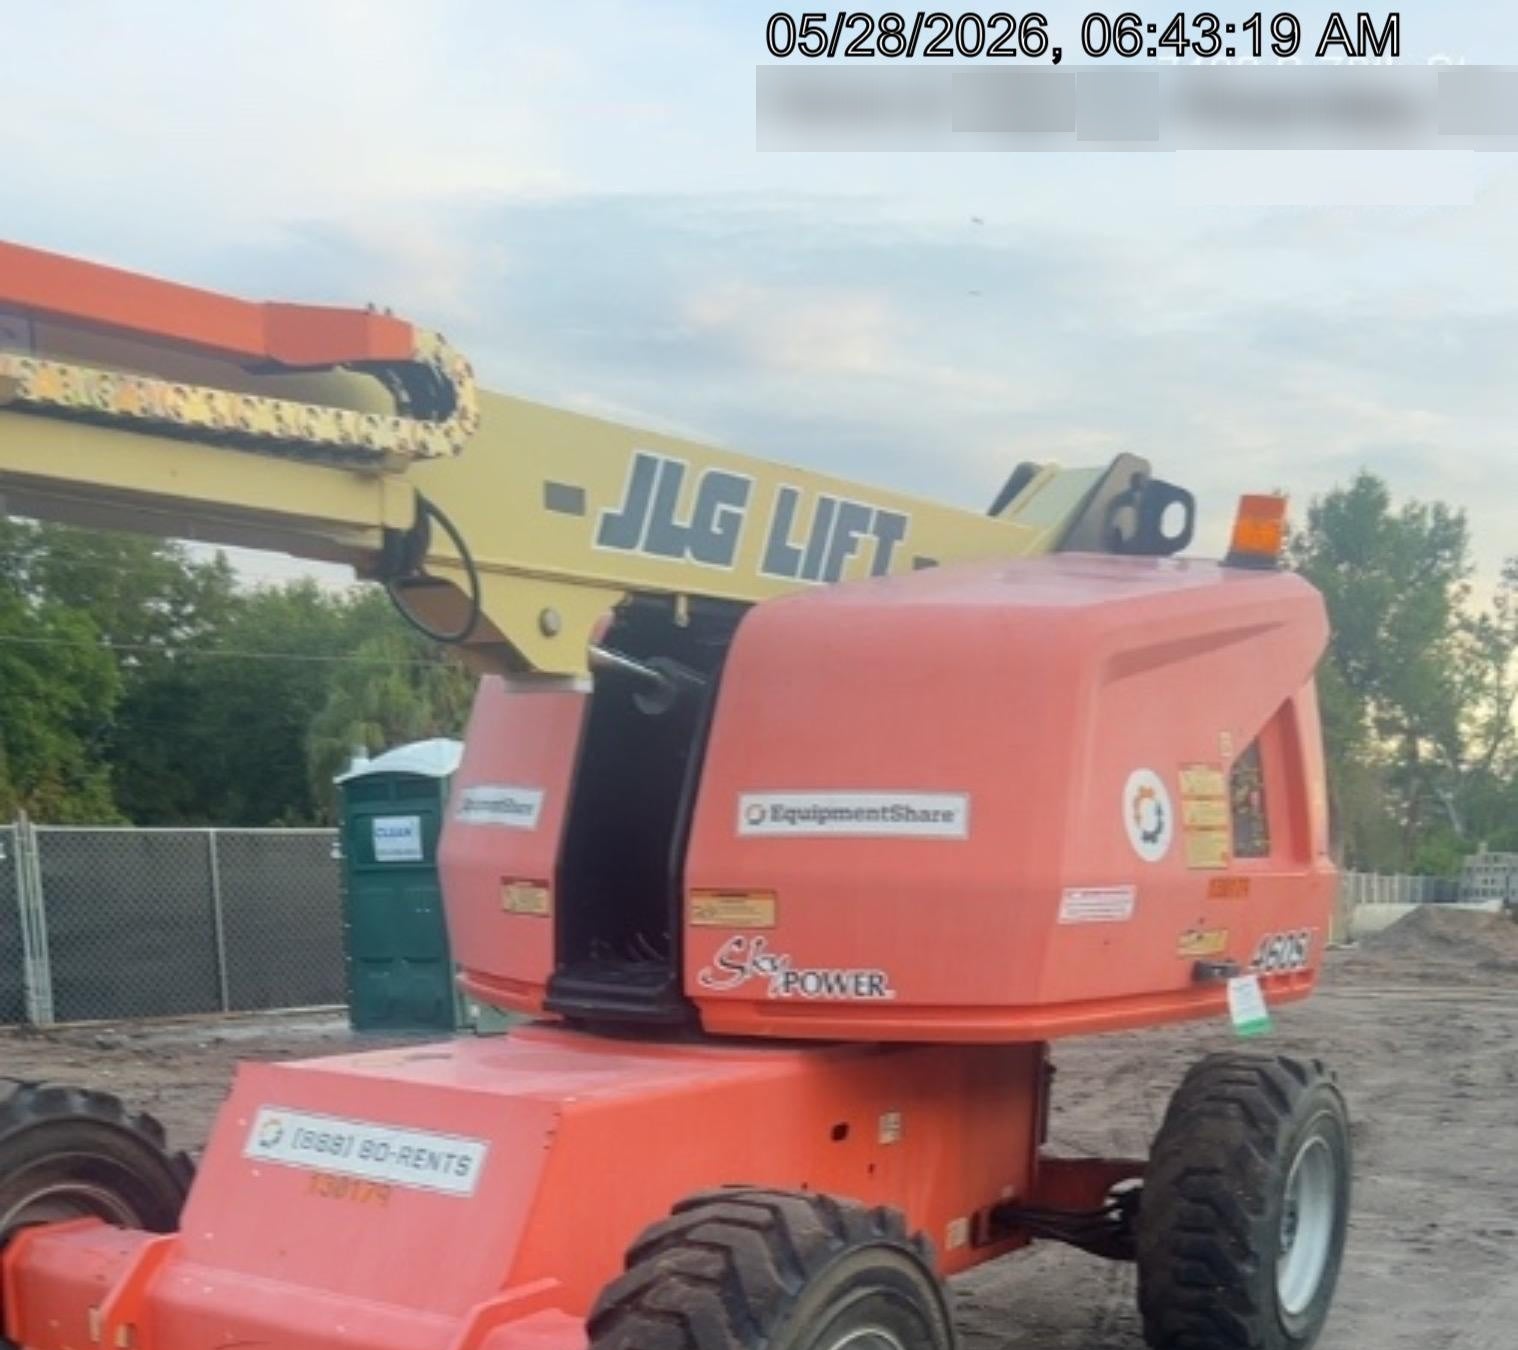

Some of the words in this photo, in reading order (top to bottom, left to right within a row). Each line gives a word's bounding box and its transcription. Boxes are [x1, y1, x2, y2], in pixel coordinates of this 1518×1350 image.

[592, 449, 756, 571] JLG
[757, 484, 911, 584] LIFT
[769, 803, 956, 825] EquipmentShare
[780, 968, 897, 999] POWER
